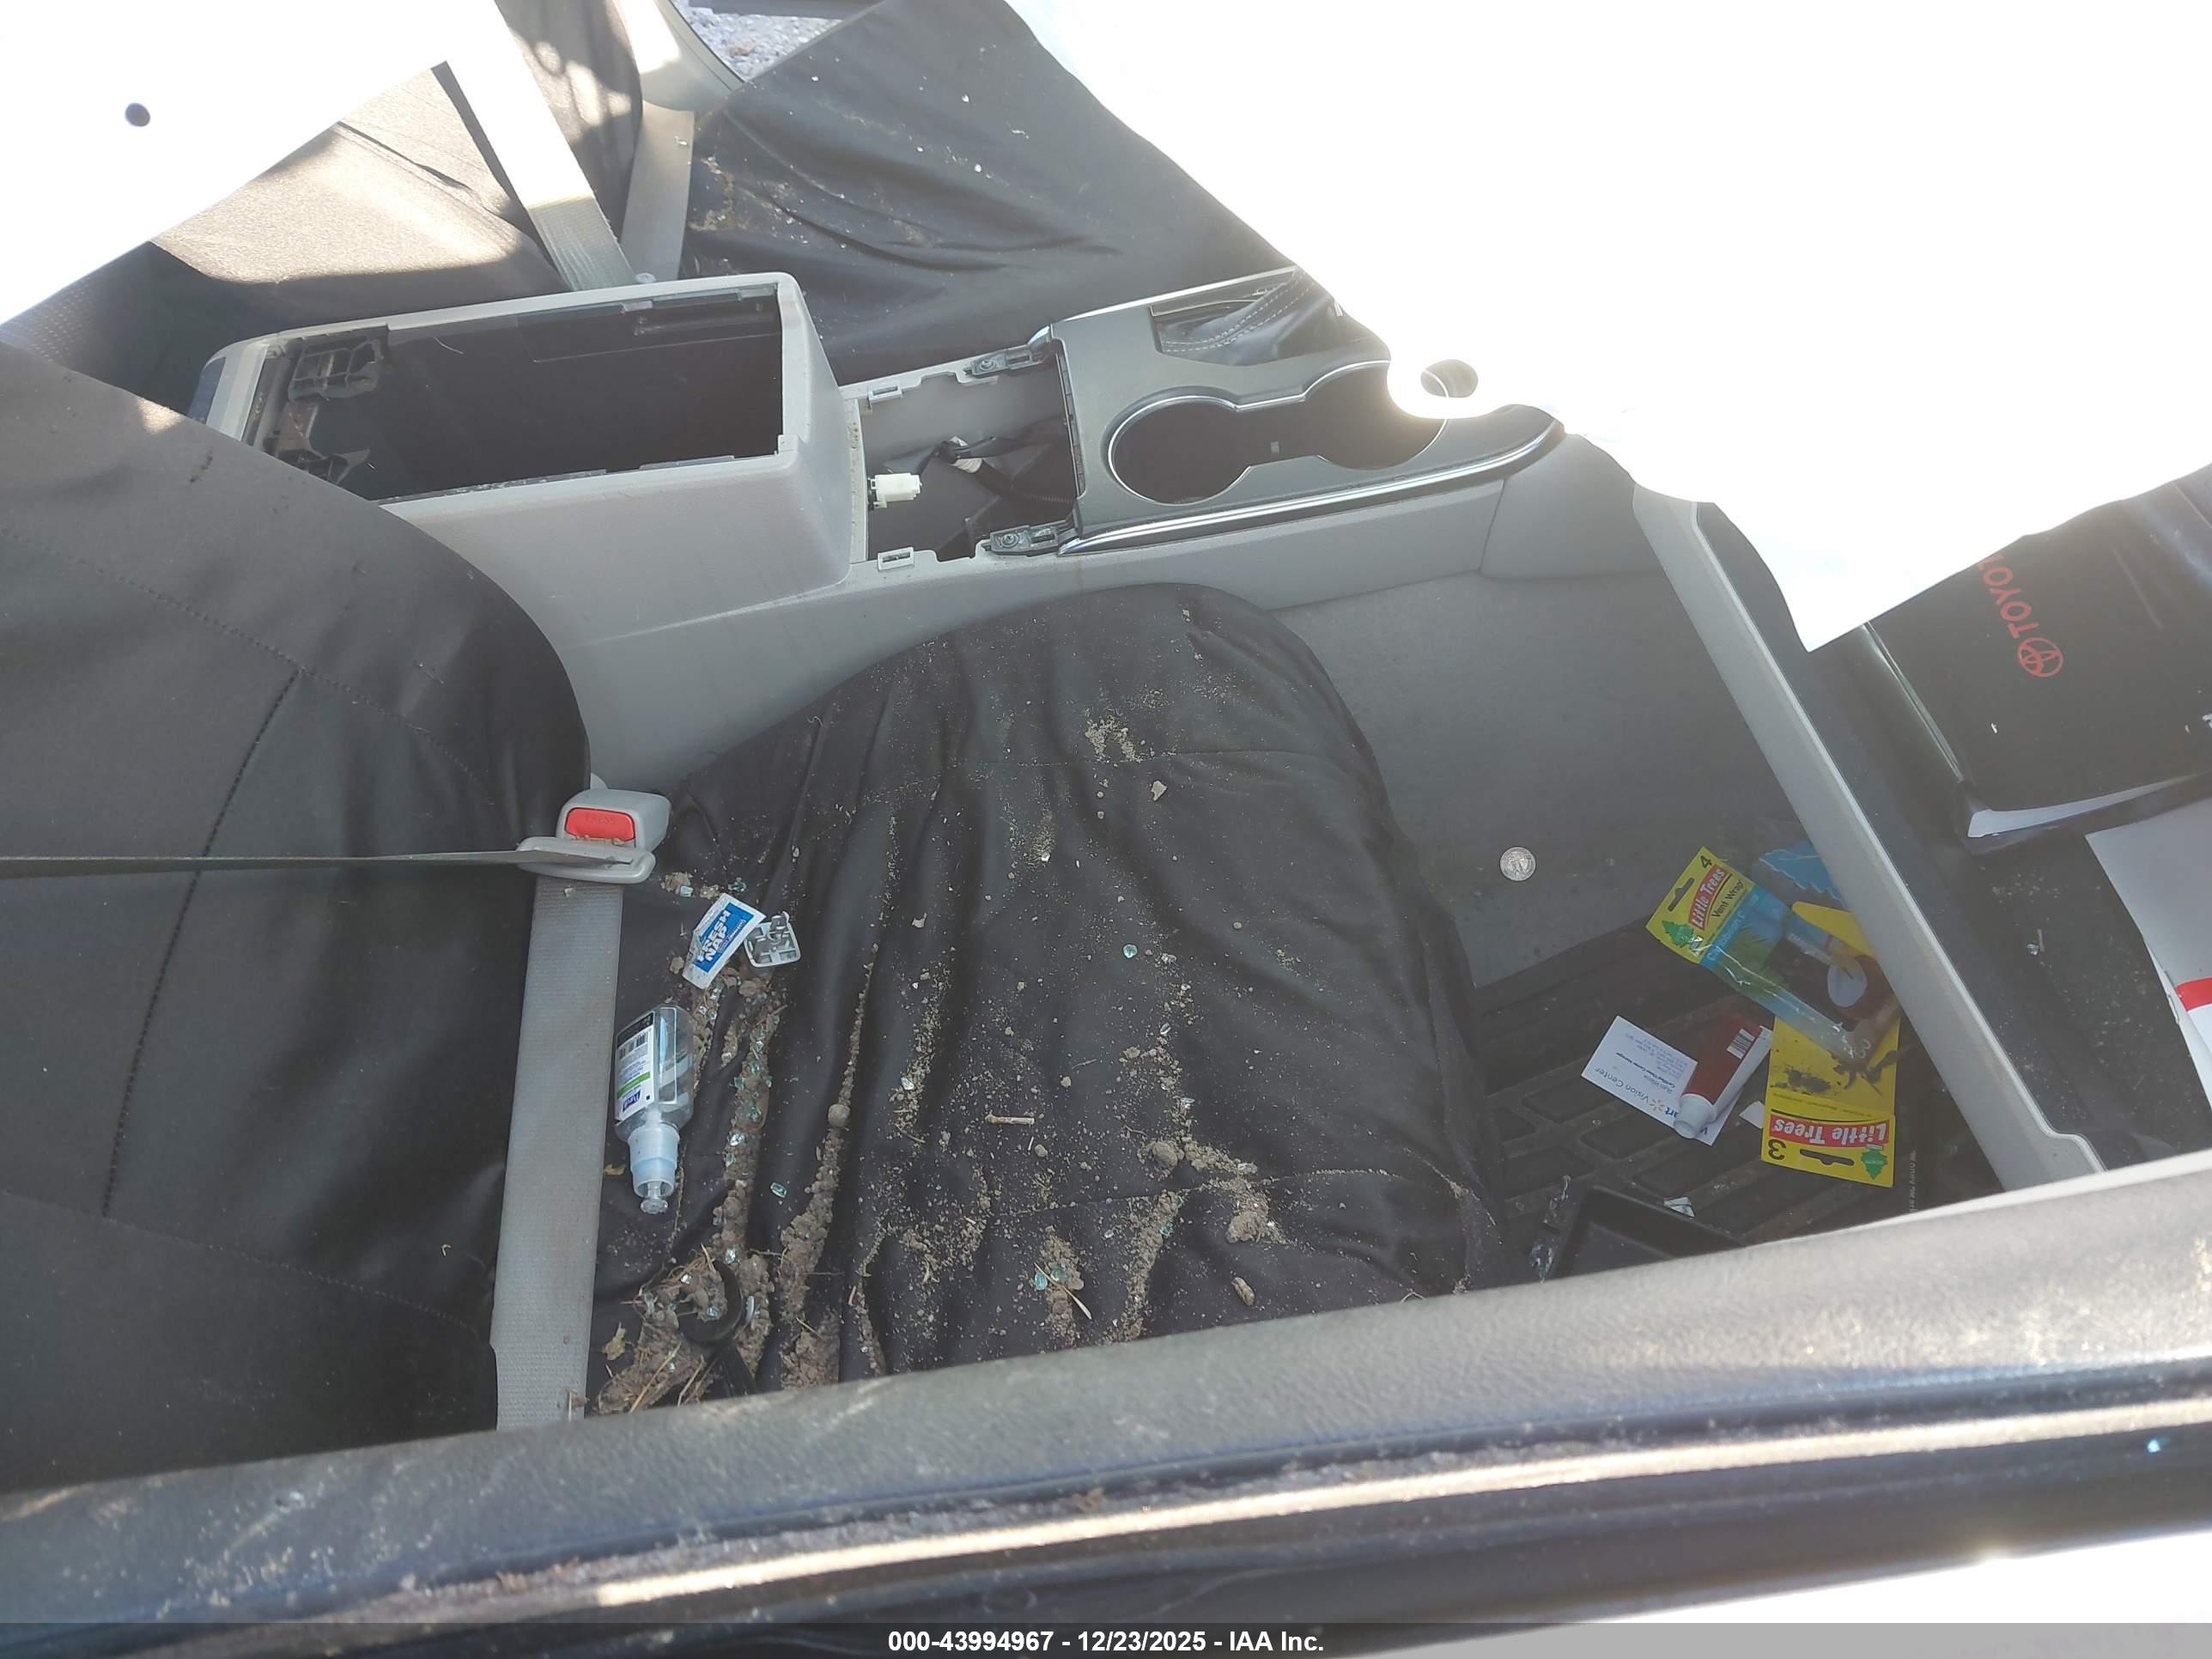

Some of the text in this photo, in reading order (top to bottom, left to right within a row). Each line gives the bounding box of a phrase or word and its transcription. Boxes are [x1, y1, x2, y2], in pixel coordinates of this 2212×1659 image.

[1978, 555, 2039, 639] TOYOT
[1700, 855, 1712, 868] 4
[1691, 868, 1724, 927] Little Trees
[1711, 879, 1744, 917] Vent Wrap
[697, 909, 732, 962] FRESH
[705, 926, 727, 962] NAP
[1595, 1067, 1624, 1088] Center
[1626, 1085, 1649, 1103] Vision
[1773, 1119, 1887, 1146] Little Trees
[1767, 1139, 1786, 1160] 3
